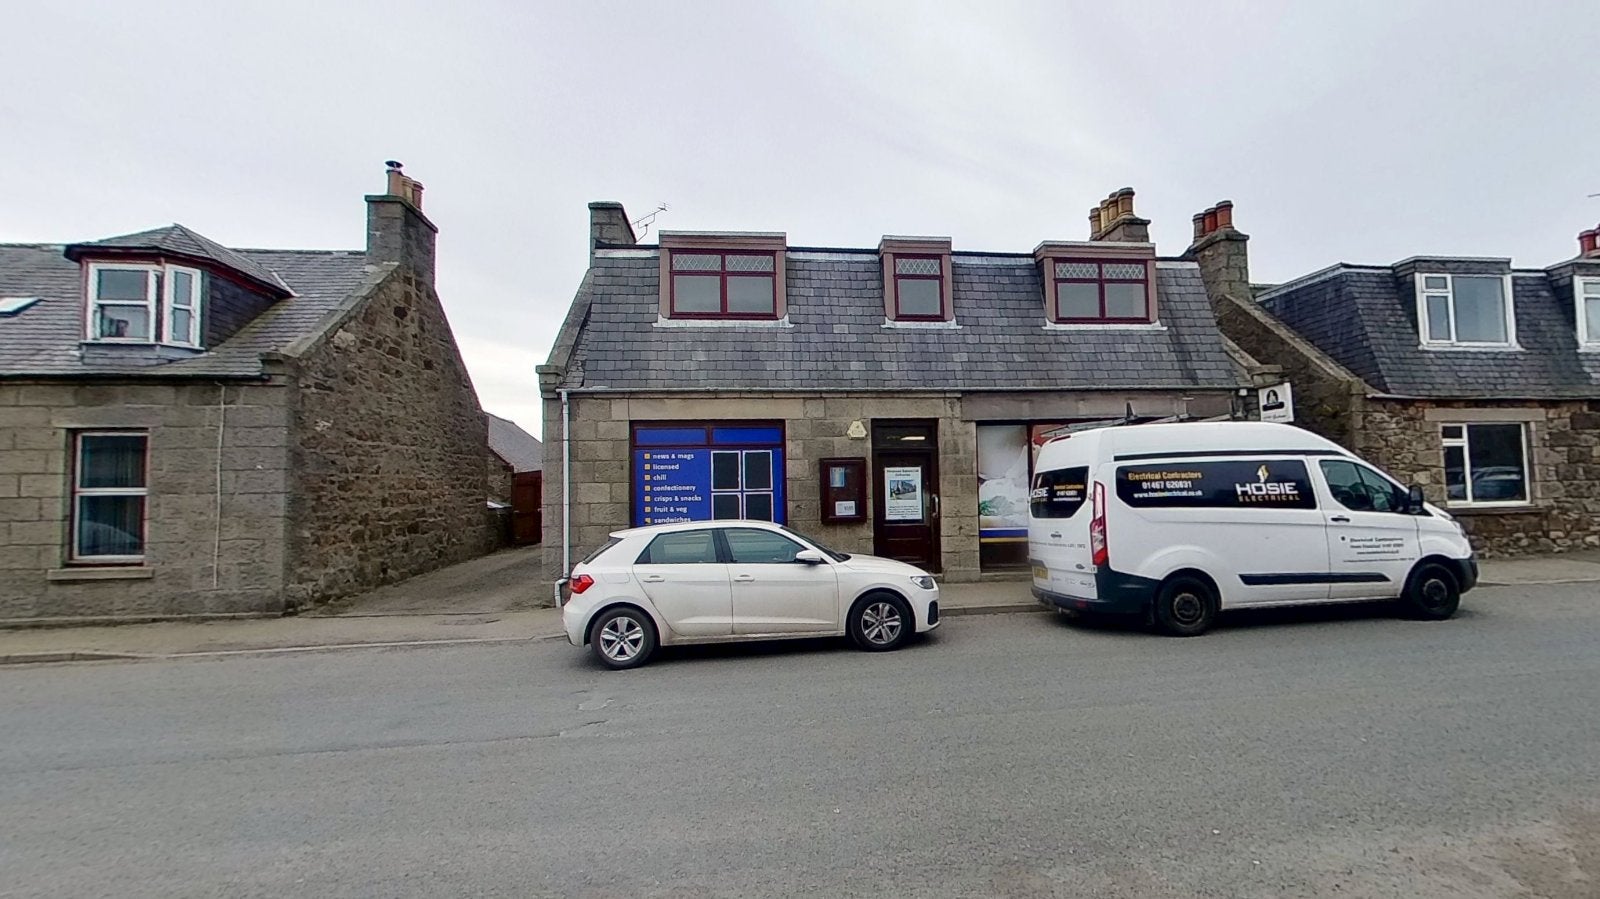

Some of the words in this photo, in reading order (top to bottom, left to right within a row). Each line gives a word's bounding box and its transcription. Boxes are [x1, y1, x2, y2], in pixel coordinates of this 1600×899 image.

[1128, 472, 1161, 480] Electrical
[1162, 471, 1202, 479] Contractors
[1141, 481, 1164, 489] 01467
[1235, 482, 1299, 495] HOSIE
